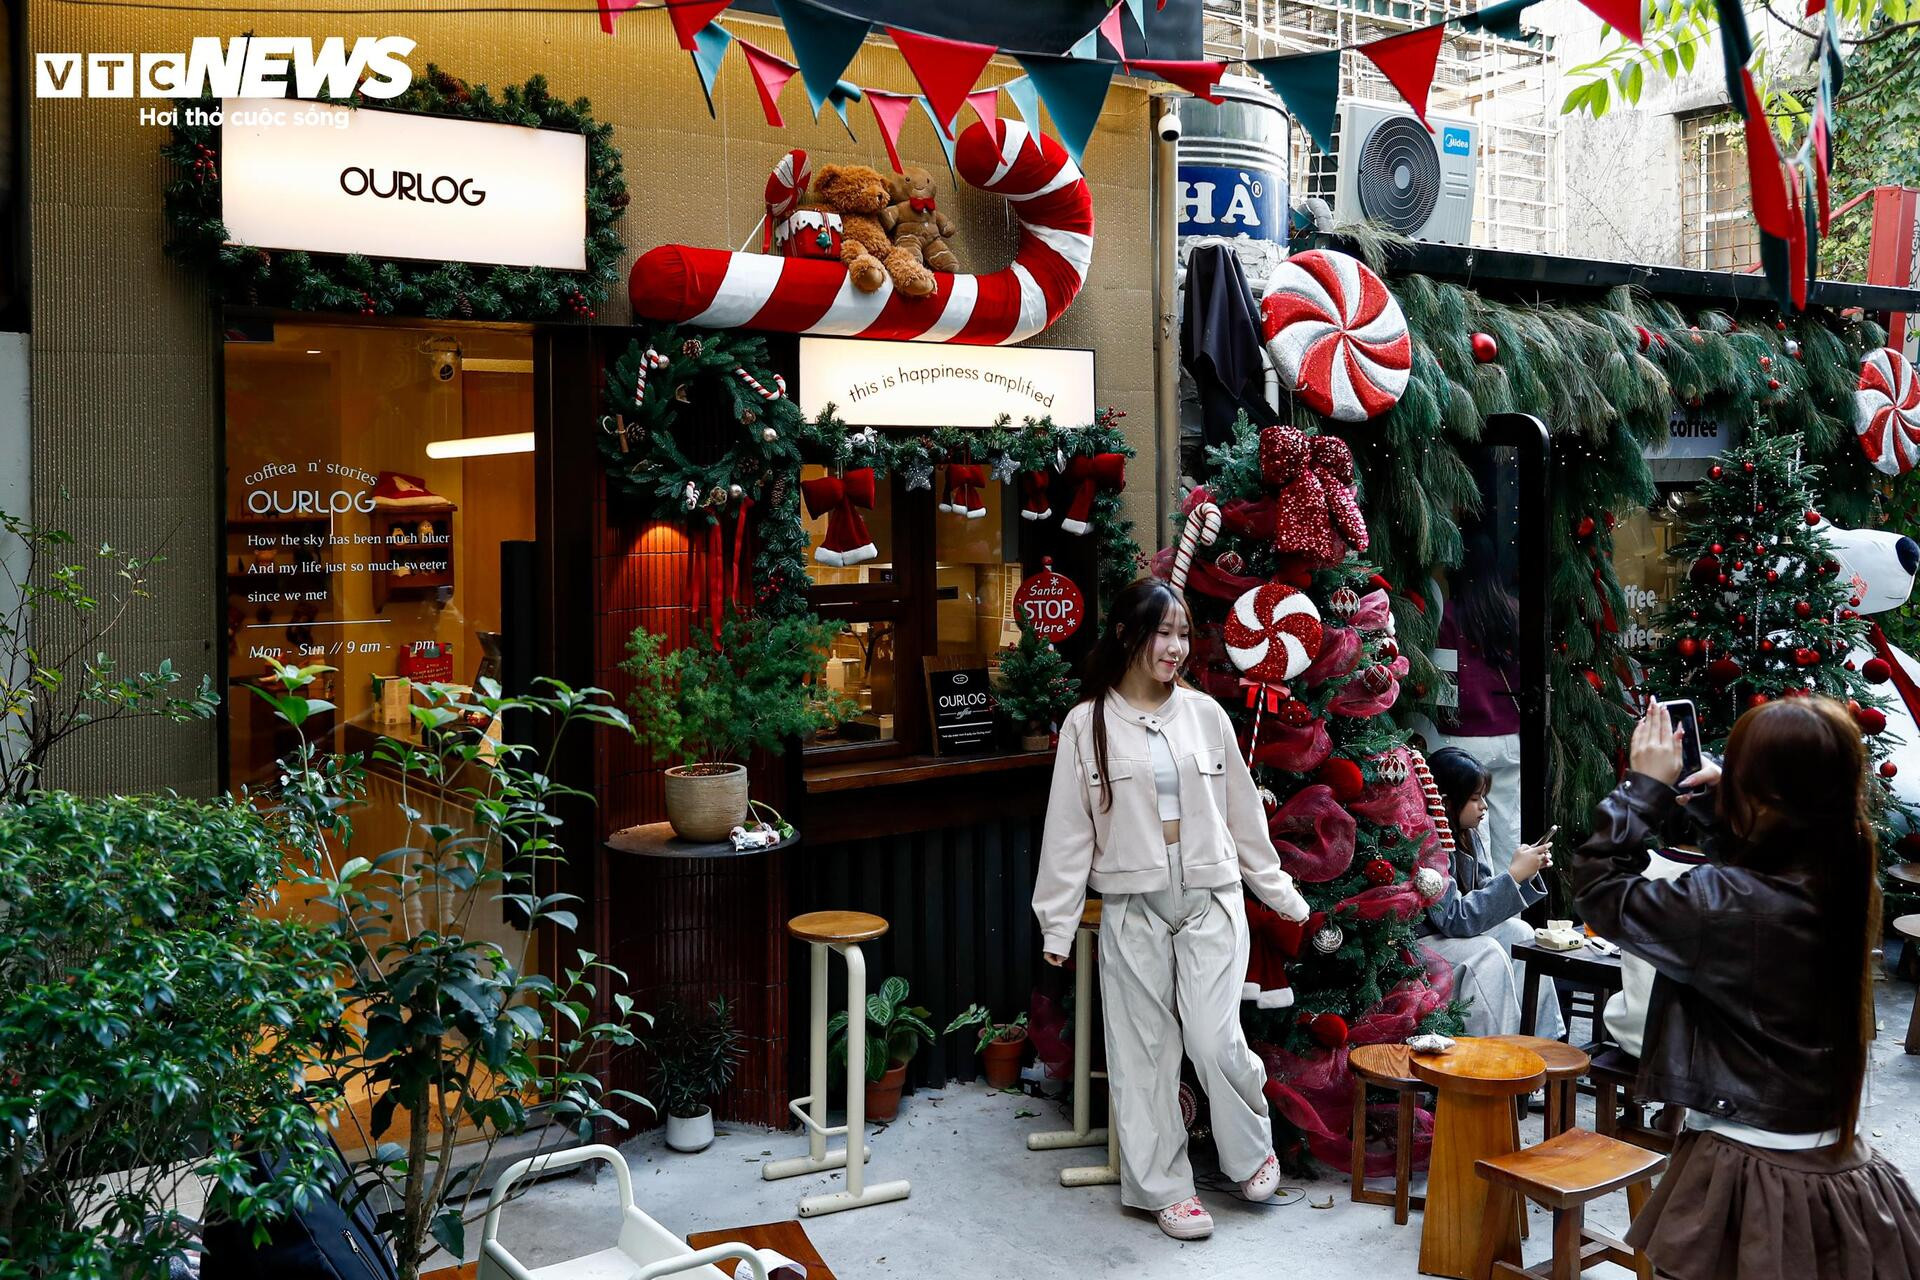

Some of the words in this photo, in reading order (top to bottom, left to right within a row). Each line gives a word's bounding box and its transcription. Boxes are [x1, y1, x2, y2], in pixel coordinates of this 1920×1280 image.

[340, 167, 486, 206] OURLOG
[849, 382, 878, 402] this
[882, 375, 895, 389] is
[898, 364, 979, 384] happiness
[984, 371, 1054, 408] amplified
[326, 462, 379, 486] stories
[248, 490, 376, 514] OURLOG
[248, 535, 277, 546] How
[281, 534, 300, 546] the
[303, 534, 325, 548] sky
[329, 534, 350, 545] has
[353, 534, 381, 545] been
[385, 533, 418, 544] much
[248, 563, 274, 574] And
[279, 564, 298, 576] my
[302, 561, 321, 573] life
[325, 562, 347, 574] just
[350, 563, 364, 572] so
[368, 560, 400, 571] much
[404, 561, 448, 571] sweeter
[247, 591, 280, 603] since
[284, 592, 301, 601] we
[305, 590, 328, 601] met
[1029, 585, 1064, 596] Santa
[1023, 600, 1074, 619] STOP
[1034, 621, 1064, 633] Here
[249, 645, 281, 659] Mon
[299, 643, 325, 657] Sun
[346, 641, 356, 654] 9
[360, 643, 381, 654] am
[414, 640, 435, 654] pm
[939, 692, 987, 708] OURLOG
